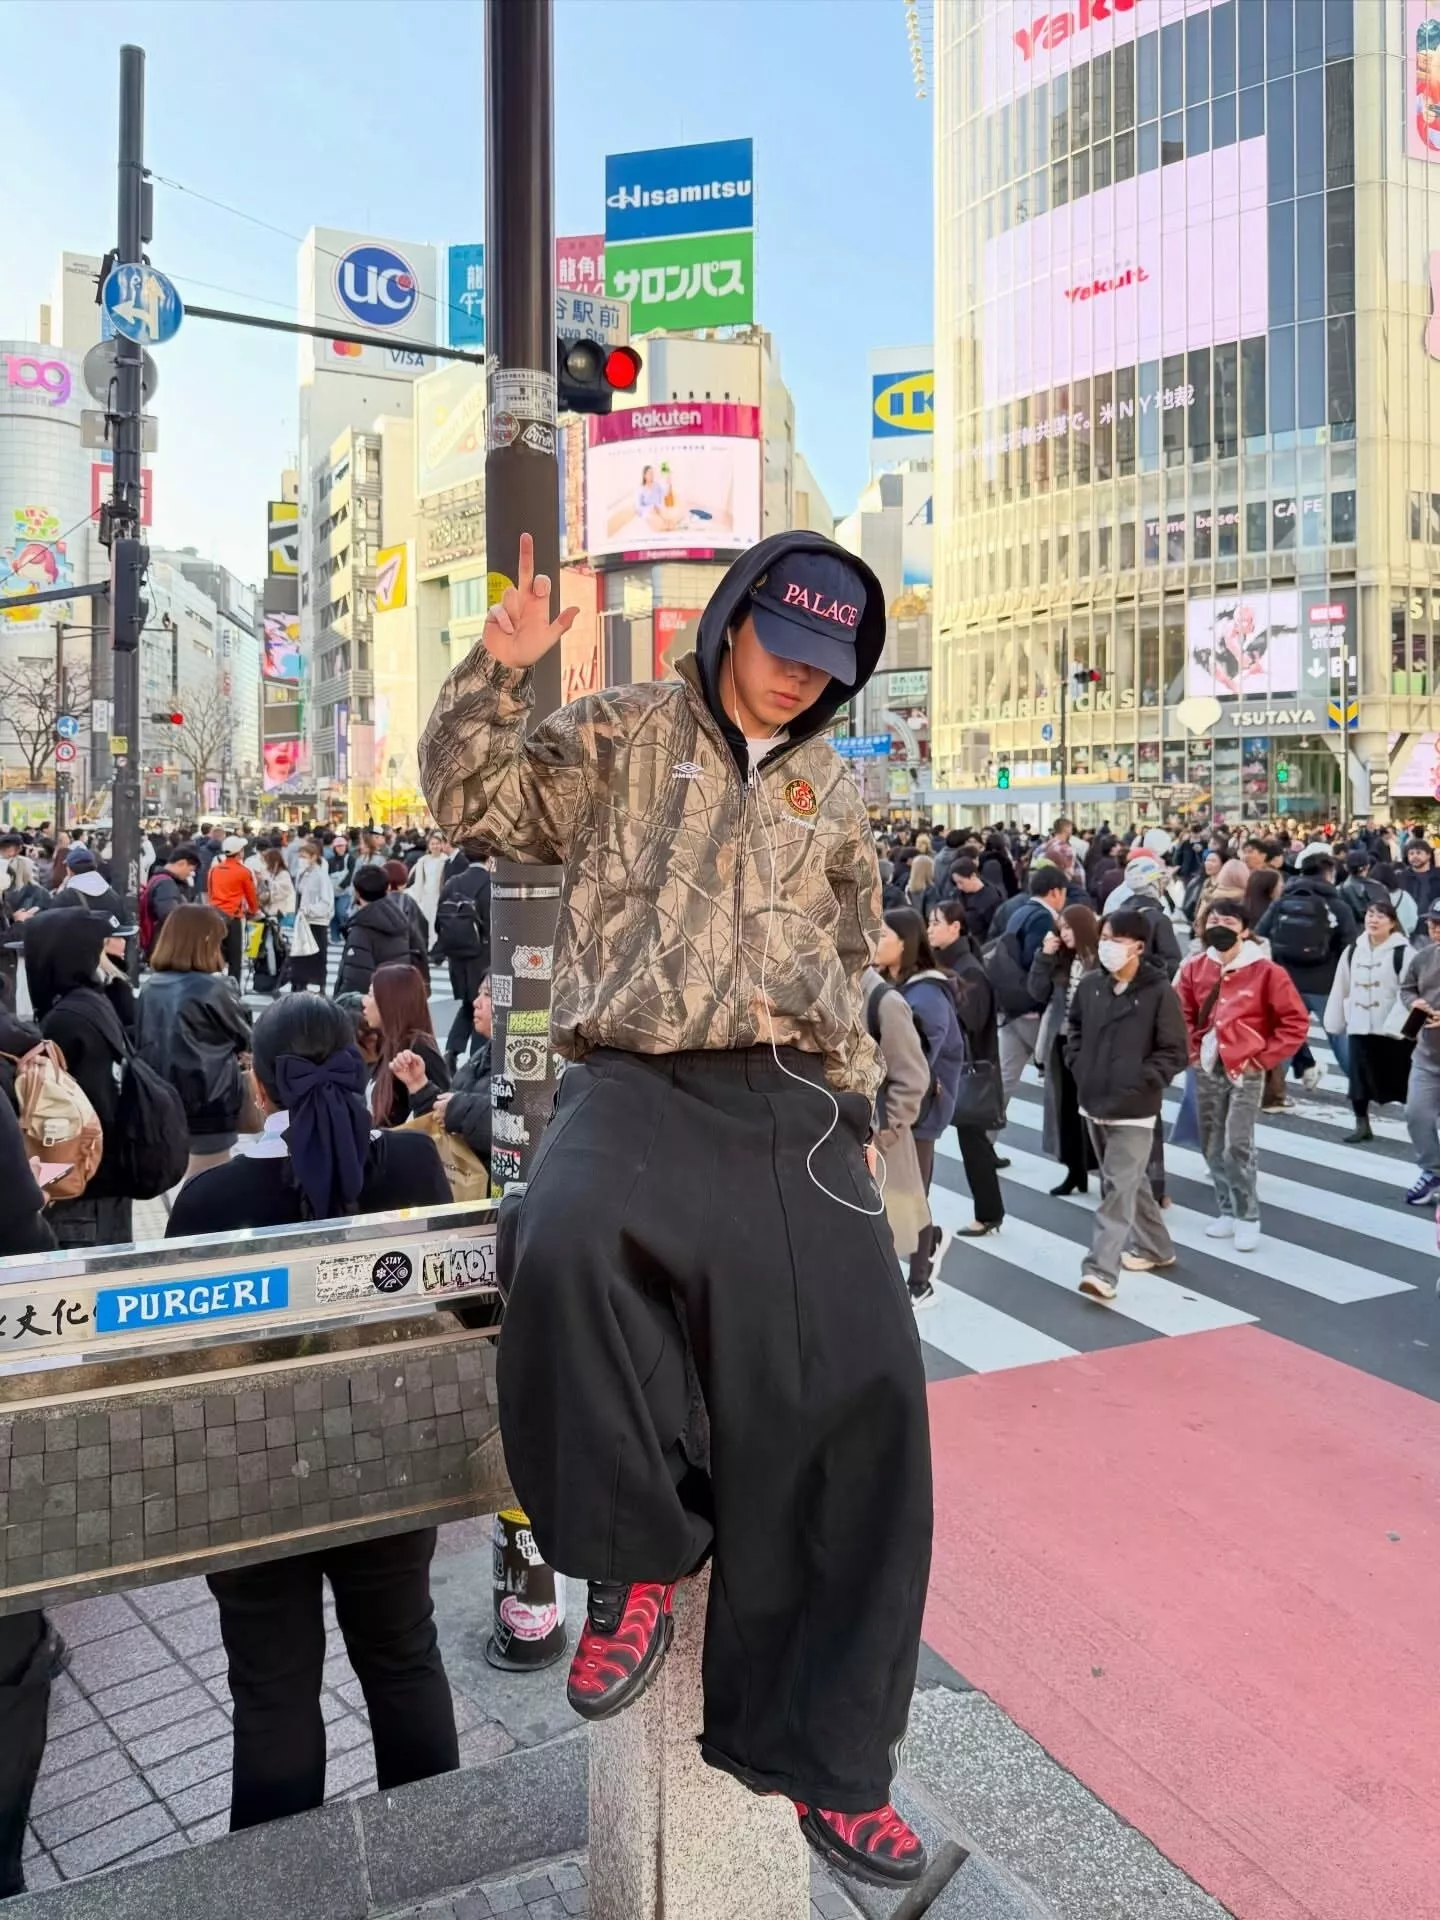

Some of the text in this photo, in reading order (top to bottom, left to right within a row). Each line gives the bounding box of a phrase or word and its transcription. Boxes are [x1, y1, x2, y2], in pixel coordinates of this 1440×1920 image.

[606, 180, 751, 210] Hisamitsu
[613, 259, 745, 304] サロンパス
[1064, 266, 1149, 303] Yakult
[391, 350, 424, 366] VISA
[4, 354, 71, 406] 109
[631, 409, 702, 429] Rakuten
[1274, 499, 1324, 518] CAFE
[783, 583, 857, 627] PALACE
[1230, 709, 1316, 727] TSUTAYA
[385, 1255, 401, 1265] STAY
[117, 1277, 270, 1324] PURGERI
[0, 1299, 97, 1339] 文化
